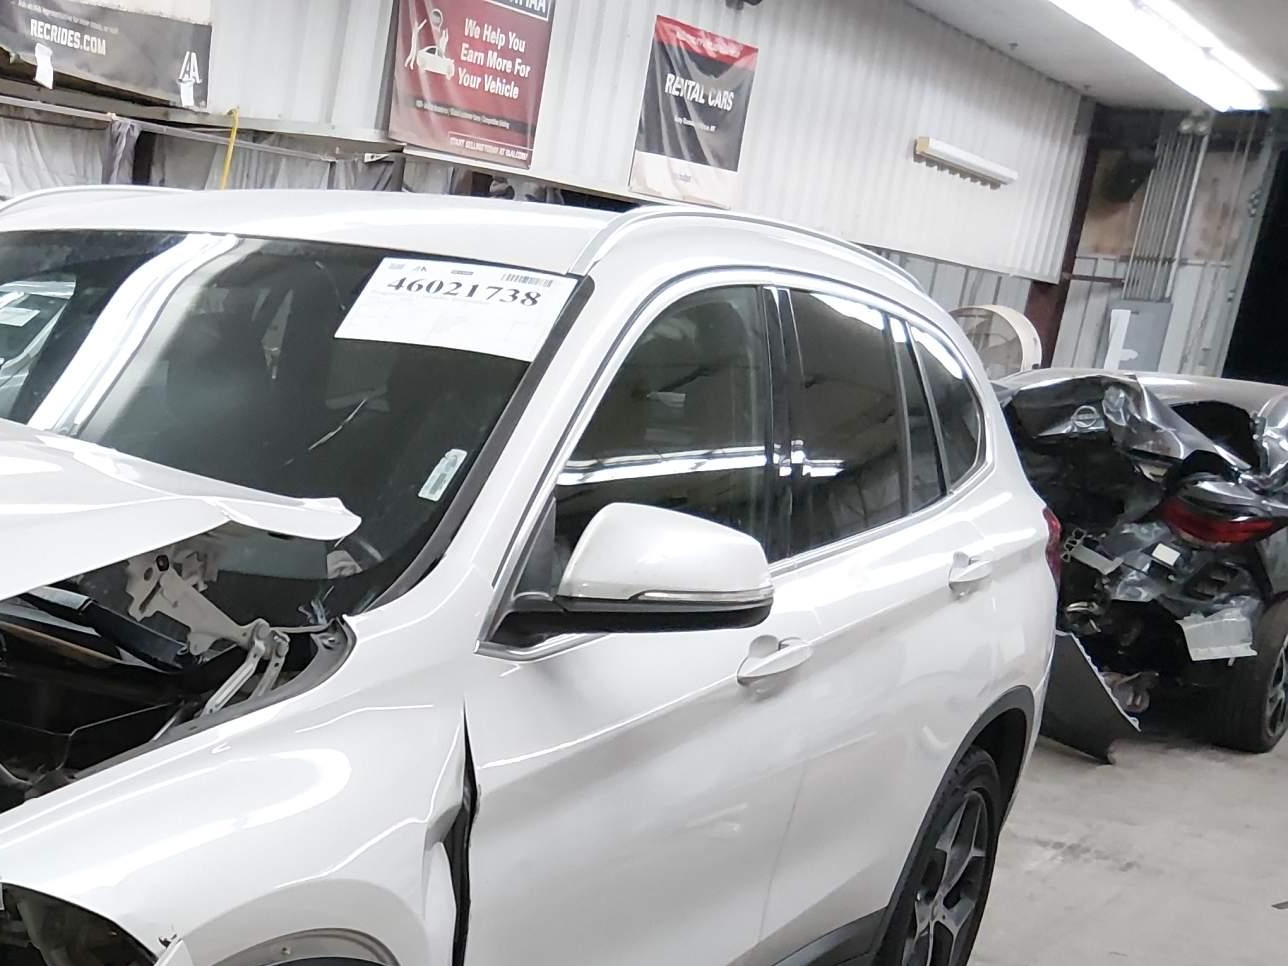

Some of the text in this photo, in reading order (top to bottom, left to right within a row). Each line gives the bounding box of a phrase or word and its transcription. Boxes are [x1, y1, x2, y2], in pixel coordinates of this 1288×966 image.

[30, 18, 107, 56] RECRIDES.COM
[464, 17, 526, 53] We Help You
[460, 43, 532, 78] Earn More For
[458, 67, 520, 99] Your Vehicle
[664, 73, 734, 111] RENTAL CARS
[387, 277, 541, 306] 46021738
